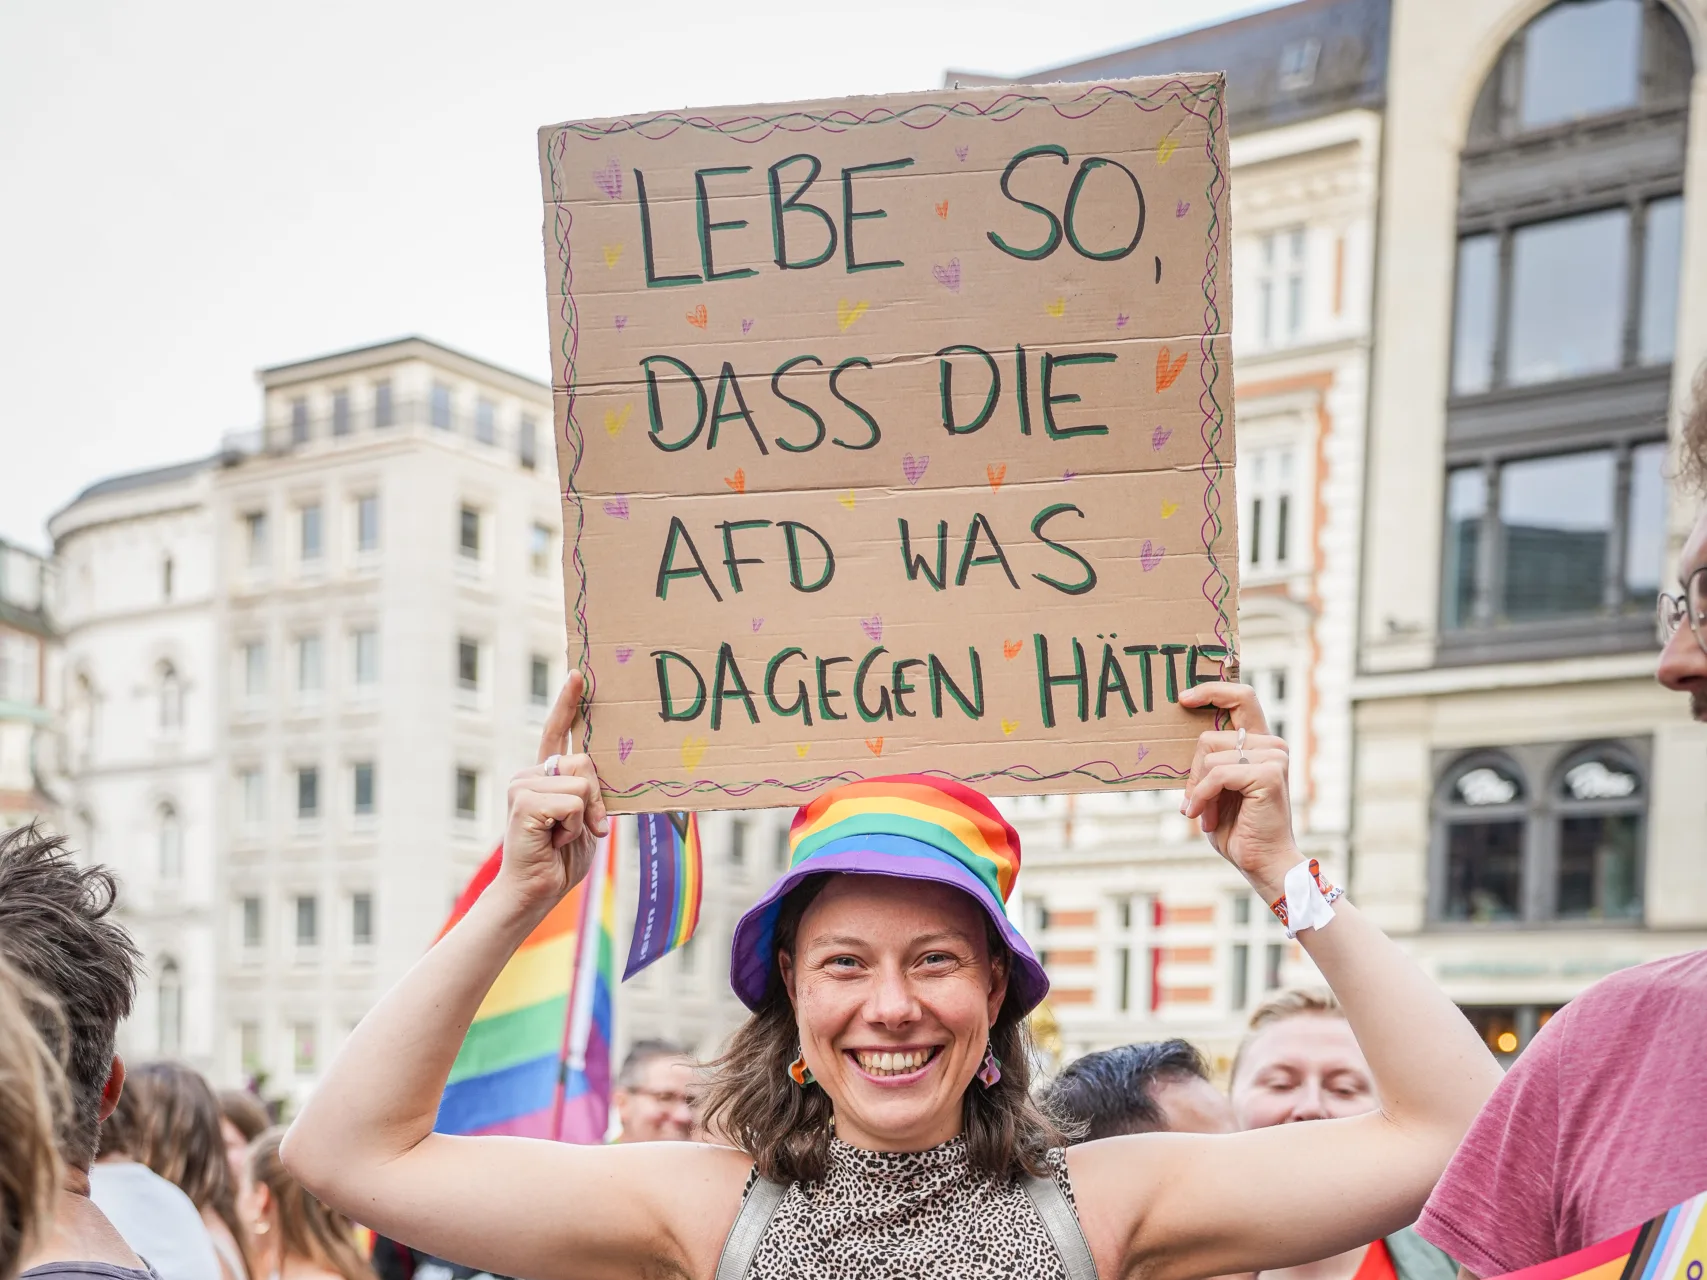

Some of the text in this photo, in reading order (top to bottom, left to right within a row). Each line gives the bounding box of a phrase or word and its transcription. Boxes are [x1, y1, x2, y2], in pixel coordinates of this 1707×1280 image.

[633, 144, 1162, 288] LEBE SO,
[639, 343, 1119, 455] DASS DIE
[655, 503, 1097, 602] AFD WAS
[650, 633, 1235, 730] DAGEGEN HÄTTE
